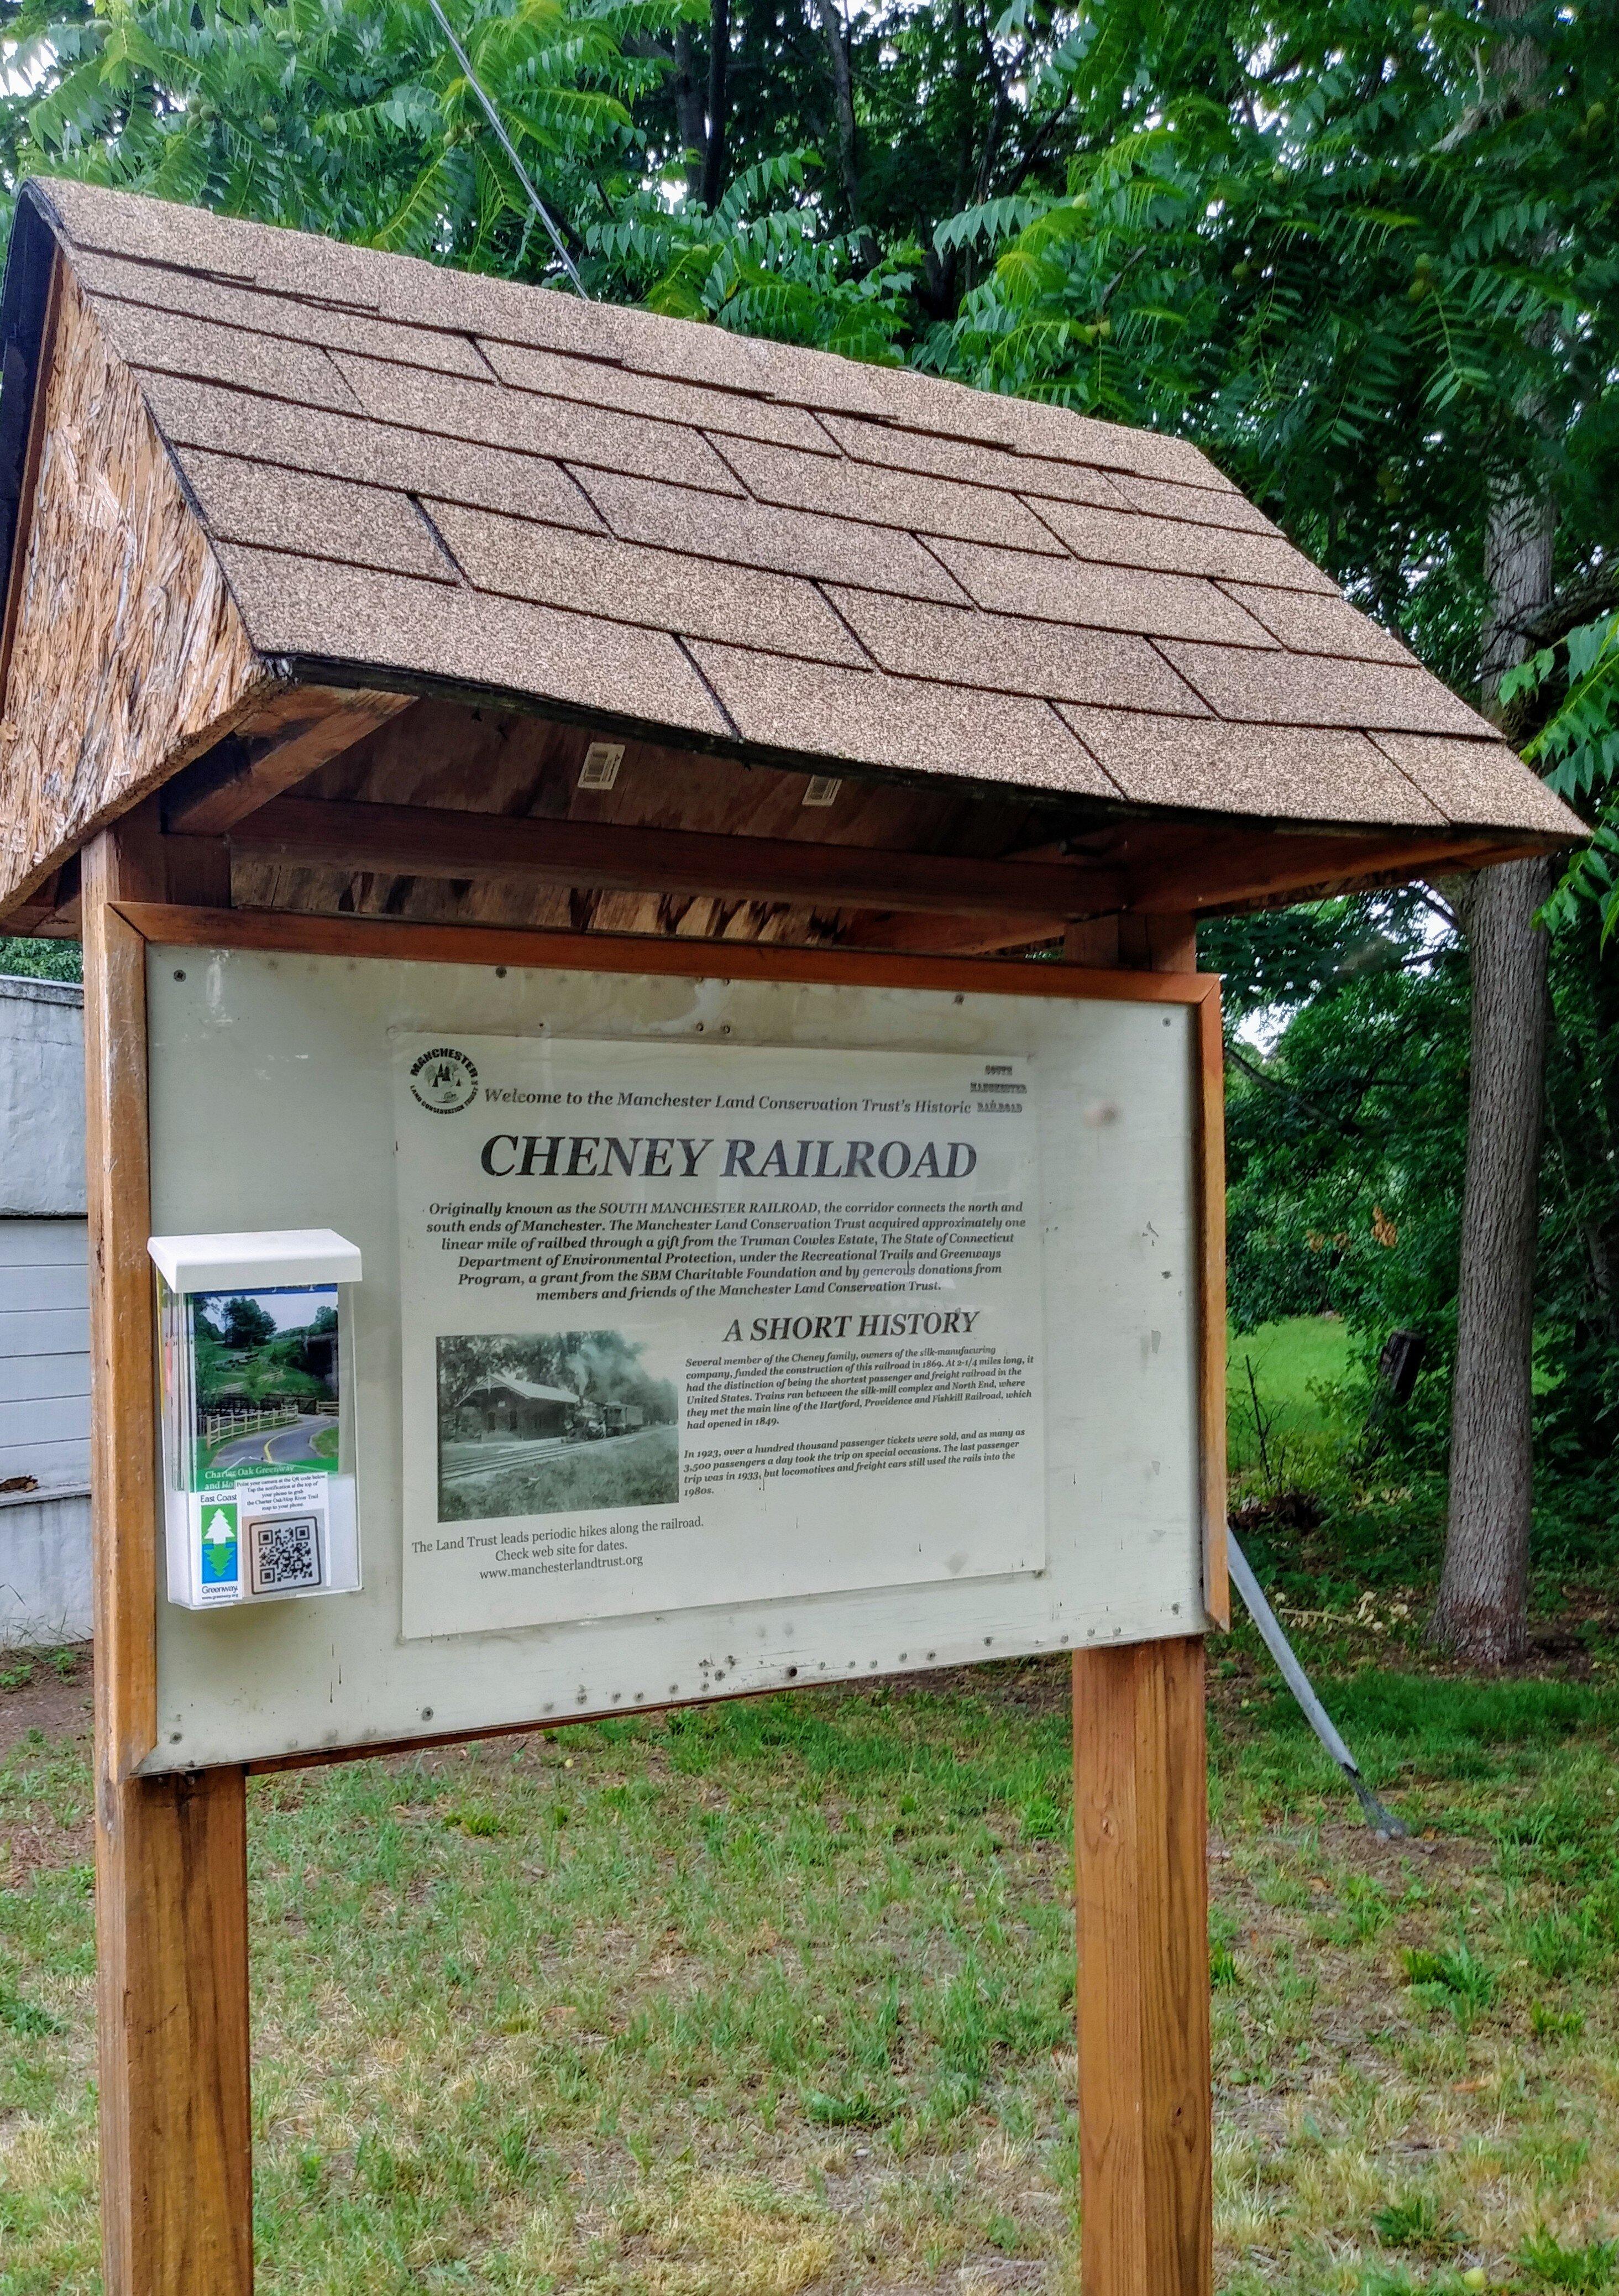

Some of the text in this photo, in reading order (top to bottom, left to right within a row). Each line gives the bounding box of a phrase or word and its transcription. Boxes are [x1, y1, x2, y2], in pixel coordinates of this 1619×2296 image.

[410, 1048, 478, 1078] MANCHESTER
[485, 1087, 971, 1113] Welcome to the Manchester Land Conservation Trust's Historic
[481, 1134, 977, 1178] CHENEY RAILROAD
[429, 1201, 1023, 1217] Originally known as the SOUTH MANCHESTER RAILROAD, the corridor connects the north and
[426, 1220, 465, 1233] south
[469, 1220, 501, 1232] ends
[505, 1220, 521, 1235] of
[521, 1219, 605, 1231] Manchester.
[609, 1219, 633, 1231] The
[636, 1218, 712, 1231] Manchester
[715, 1216, 747, 1230] Land
[751, 1218, 831, 1230] Conservation
[834, 1218, 866, 1228] Trust
[868, 1217, 919, 1231] acquired
[922, 1217, 1002, 1231] approximately
[458, 1274, 525, 1288] Program,
[541, 1273, 579, 1286] grant
[579, 1270, 614, 1285] from
[618, 1270, 638, 1282] the
[641, 1270, 672, 1281] SBM
[675, 1268, 743, 1280] Charitable
[746, 1267, 816, 1279] Foundation
[820, 1266, 842, 1277] and
[846, 1265, 860, 1279] by
[918, 1264, 972, 1274] donations
[973, 1263, 1002, 1277] from
[536, 1281, 941, 1301] members and friends of the Manchester Land Conservation Trust.
[721, 1309, 980, 1342] A SHORT HISTORY
[685, 1357, 722, 1367] Several
[724, 1354, 762, 1365] member
[764, 1354, 774, 1367] of
[775, 1354, 789, 1363] the
[792, 1353, 825, 1362] Cheney
[895, 1349, 904, 1359] of
[905, 1348, 918, 1357] the
[686, 1372, 732, 1380] company,
[733, 1367, 767, 1379] funded
[770, 1367, 784, 1375] the
[786, 1364, 842, 1374] construction
[845, 1363, 855, 1373] of
[856, 1362, 872, 1371] this
[874, 1361, 910, 1370] railroad
[979, 1357, 1002, 1365] miles
[1003, 1356, 1025, 1368] long,
[687, 1417, 779, 1430] had opened in 1849.
[713, 1460, 766, 1471] passengers
[776, 1456, 793, 1466] day
[795, 1453, 815, 1463] took
[818, 1452, 831, 1461] the
[834, 1451, 850, 1462] trip
[865, 1447, 896, 1460] special
[898, 1446, 941, 1456] occasions.
[944, 1444, 958, 1452] The
[960, 1443, 975, 1451] last
[977, 1442, 1019, 1454] passenger
[238, 1467, 254, 1477] Oak
[205, 1481, 220, 1490] and
[684, 1484, 714, 1496] 1980s.
[412, 1516, 704, 1553] The Land Trust leads periodic hikes along the railroad.
[496, 1540, 627, 1561] Check web site for dates.
[479, 1556, 643, 1579] www.manchesterlandtrust.org
